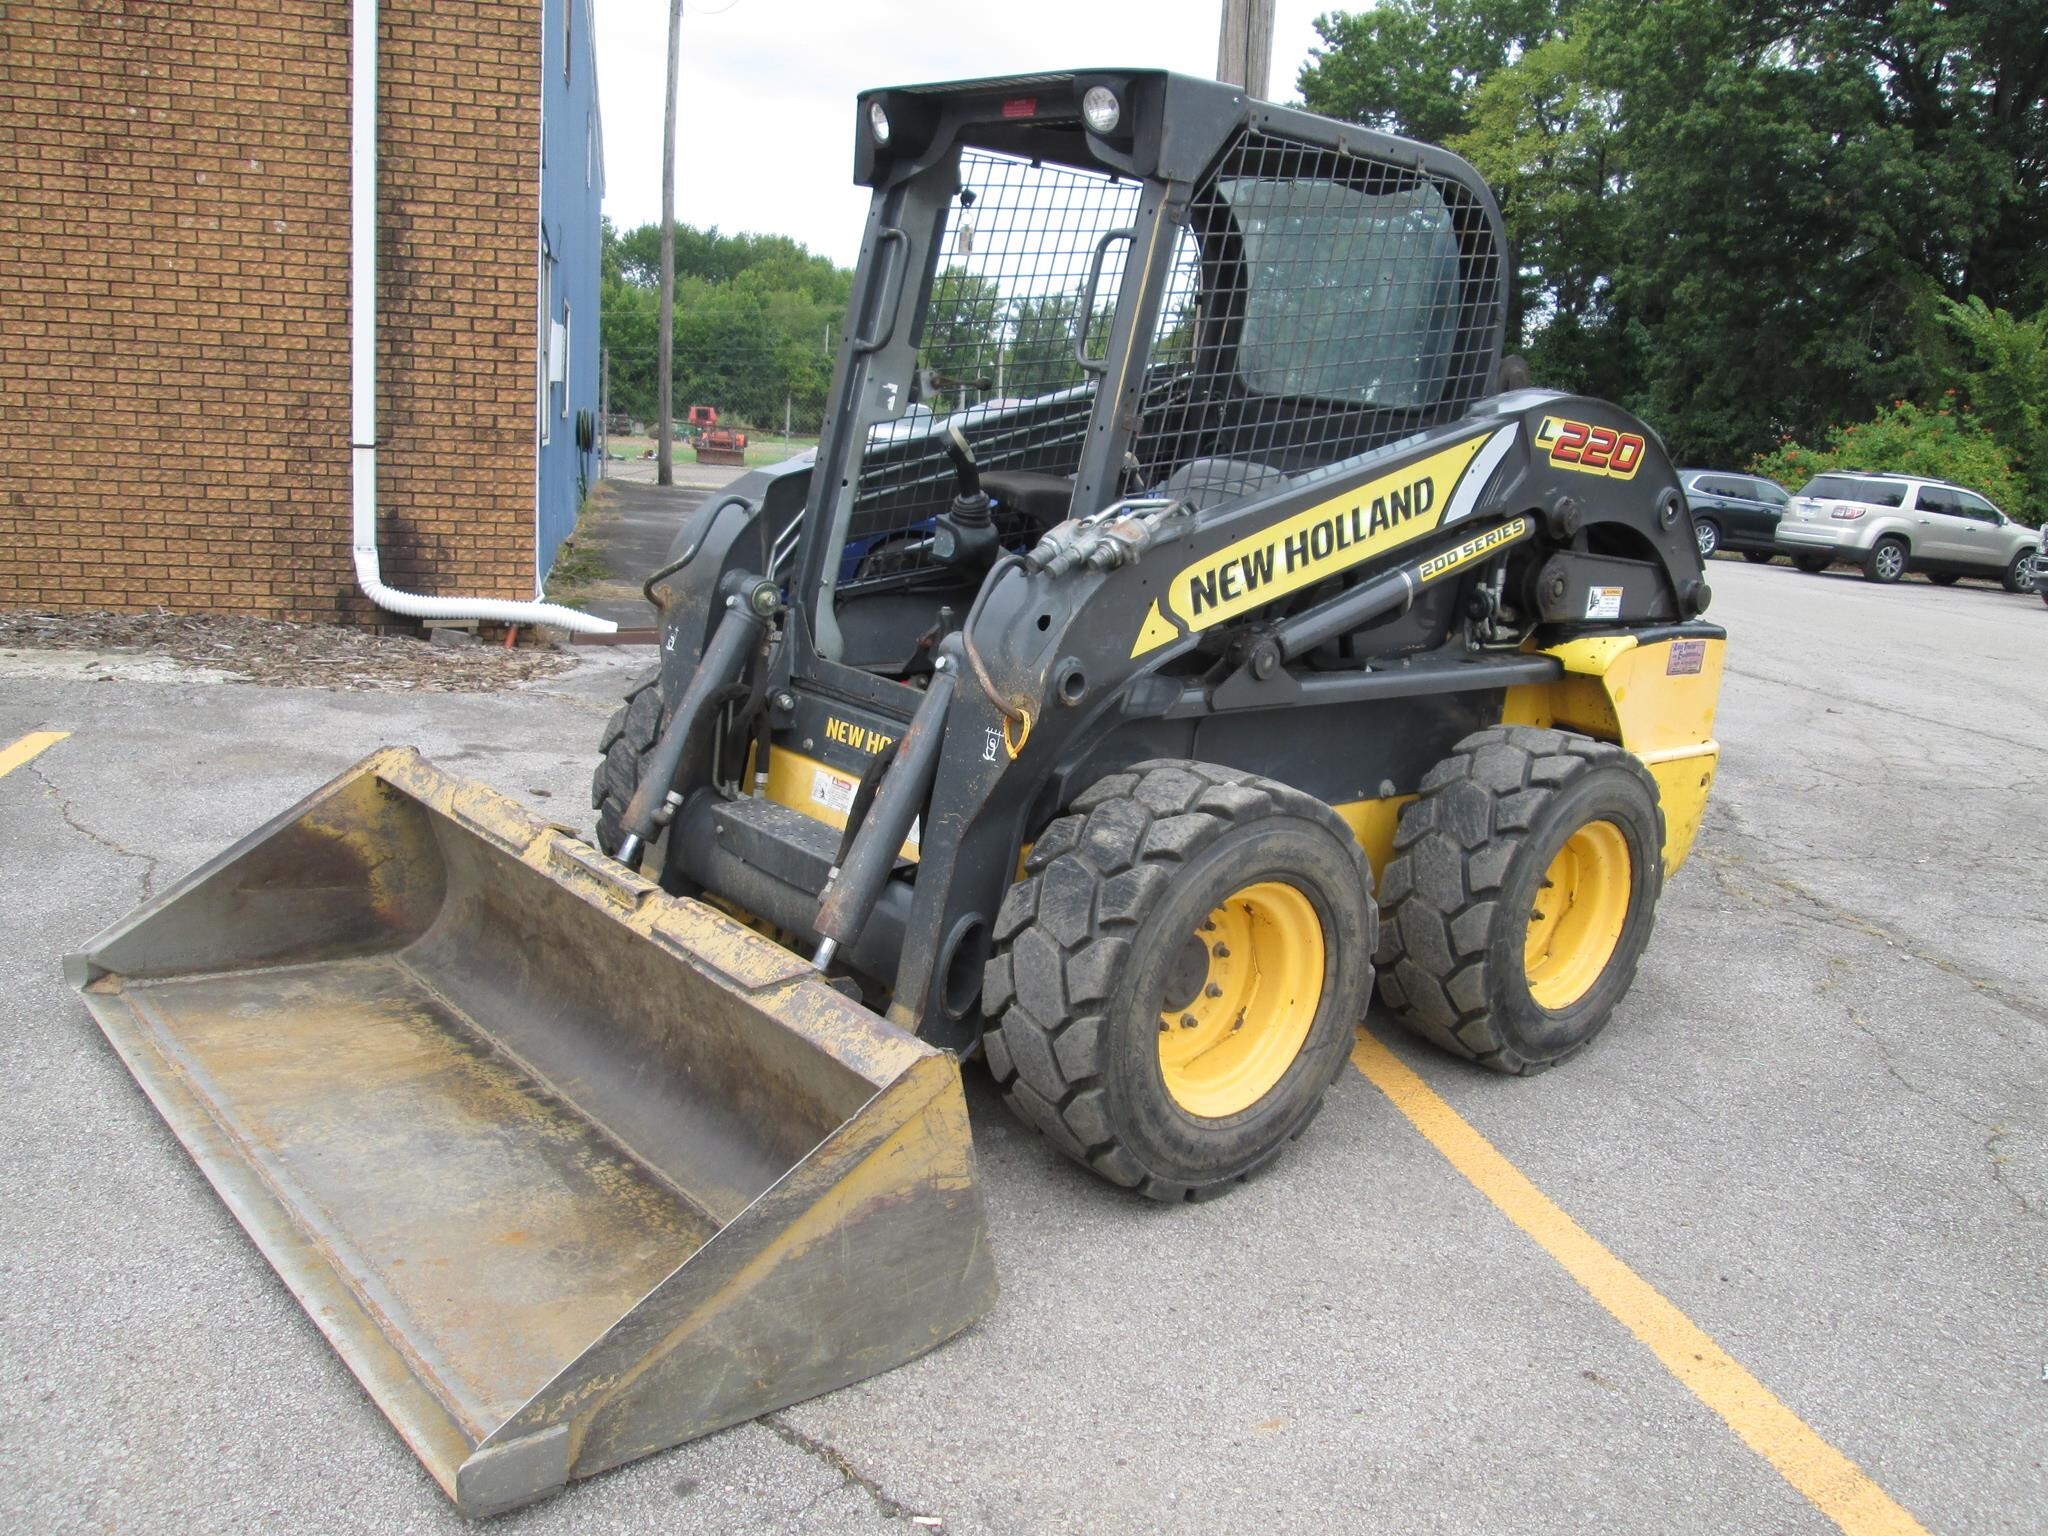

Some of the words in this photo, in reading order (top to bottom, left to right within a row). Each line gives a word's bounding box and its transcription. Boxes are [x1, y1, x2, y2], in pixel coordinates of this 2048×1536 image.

[1537, 418, 1644, 474] L220
[1189, 541, 1276, 617] NEW
[1284, 475, 1435, 575] HOLLAND
[1421, 550, 1459, 578] 200
[1462, 519, 1524, 558] SERIES
[825, 717, 866, 749] NEW
